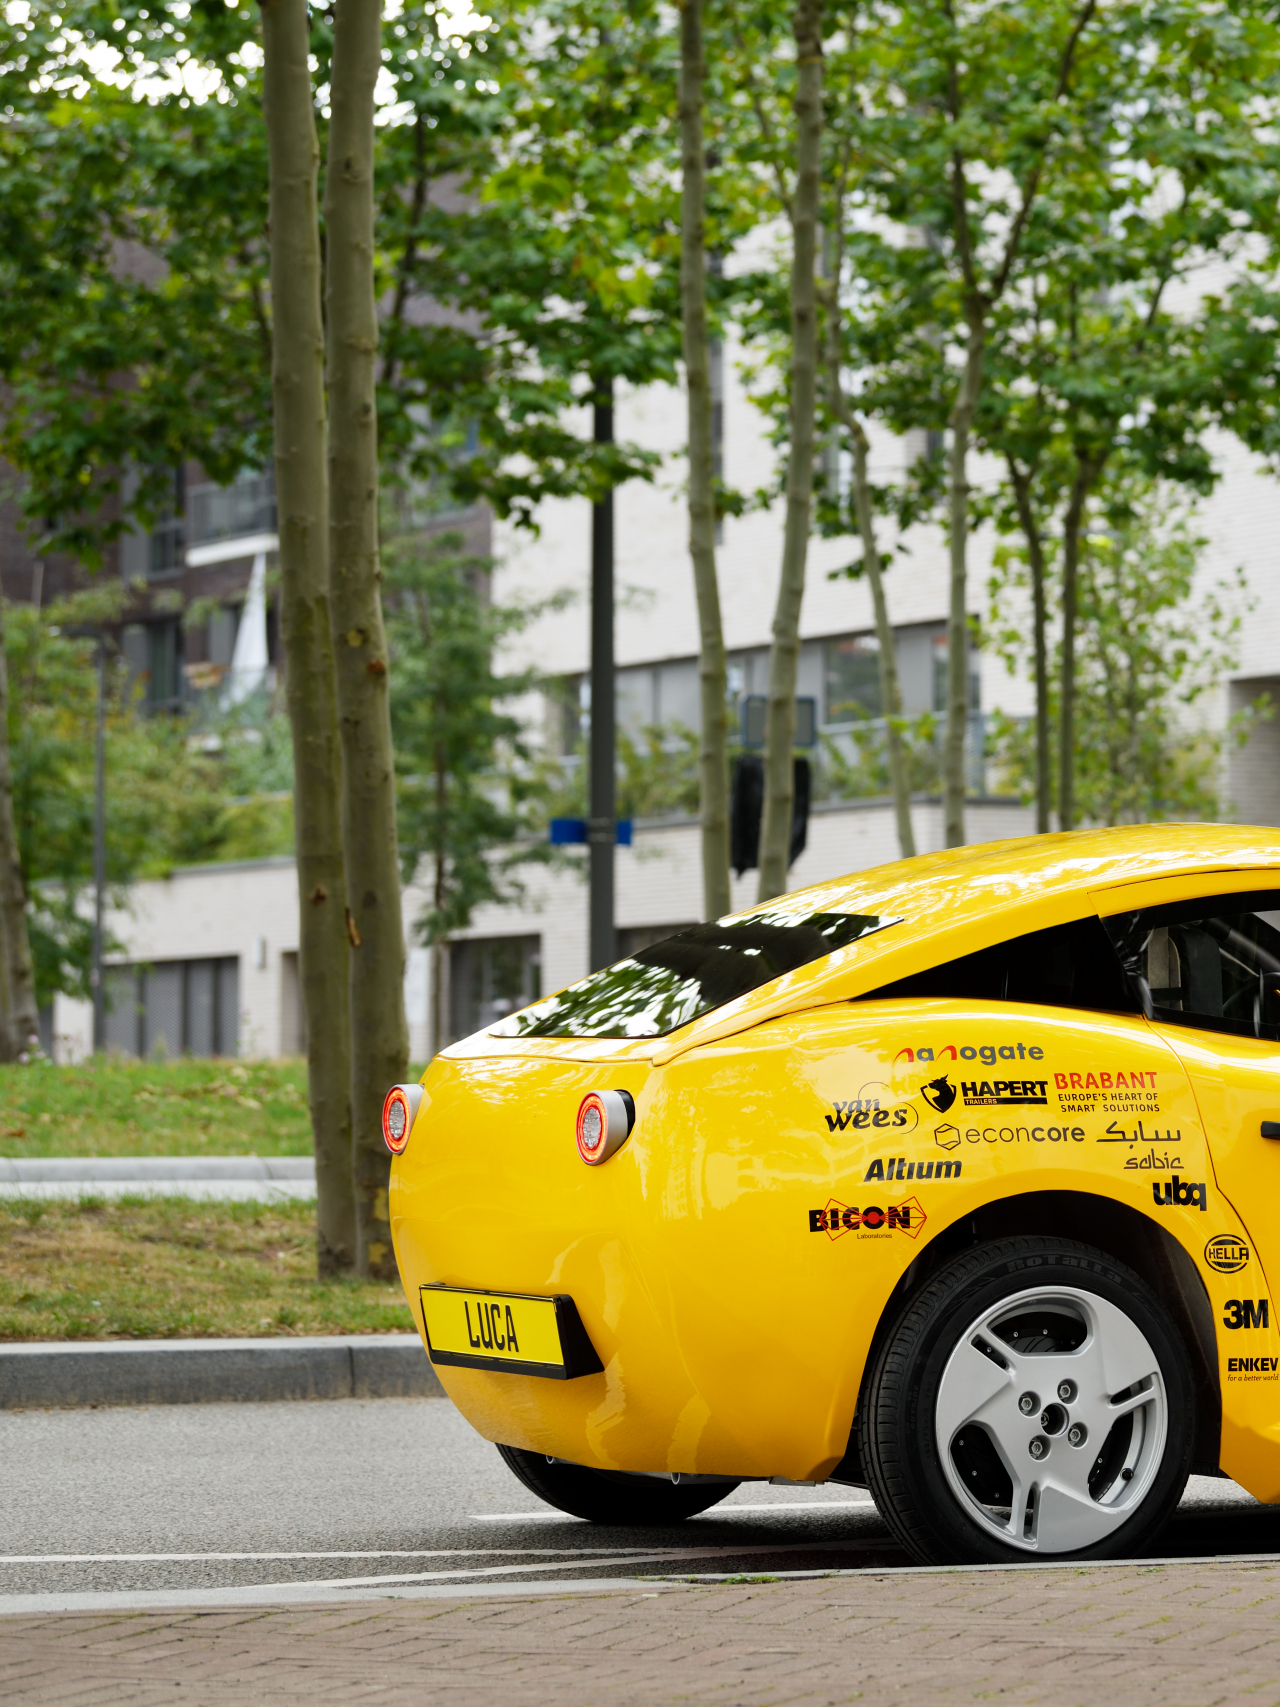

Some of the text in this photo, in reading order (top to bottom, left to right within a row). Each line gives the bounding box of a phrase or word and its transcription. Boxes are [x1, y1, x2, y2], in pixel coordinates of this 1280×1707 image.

[892, 1043, 1044, 1066] nanogate
[960, 1081, 1048, 1097] HAPERT
[1054, 1072, 1157, 1090] BRABANT
[833, 1099, 880, 1114] van
[1058, 1093, 1158, 1101] EUROPE'S HEART OF
[1103, 1104, 1160, 1112] SOLUTIONS
[825, 1109, 907, 1132] wees
[965, 1127, 1085, 1143] econcore
[1123, 1148, 1184, 1169] sabic
[863, 1158, 962, 1182] Altium
[1152, 1175, 1207, 1211] ubq
[809, 1206, 910, 1232] BICON
[1208, 1247, 1249, 1261] HELLA
[1223, 1299, 1269, 1329] 3M
[464, 1301, 519, 1353] LUCA
[1228, 1358, 1279, 1372] ENKEV
